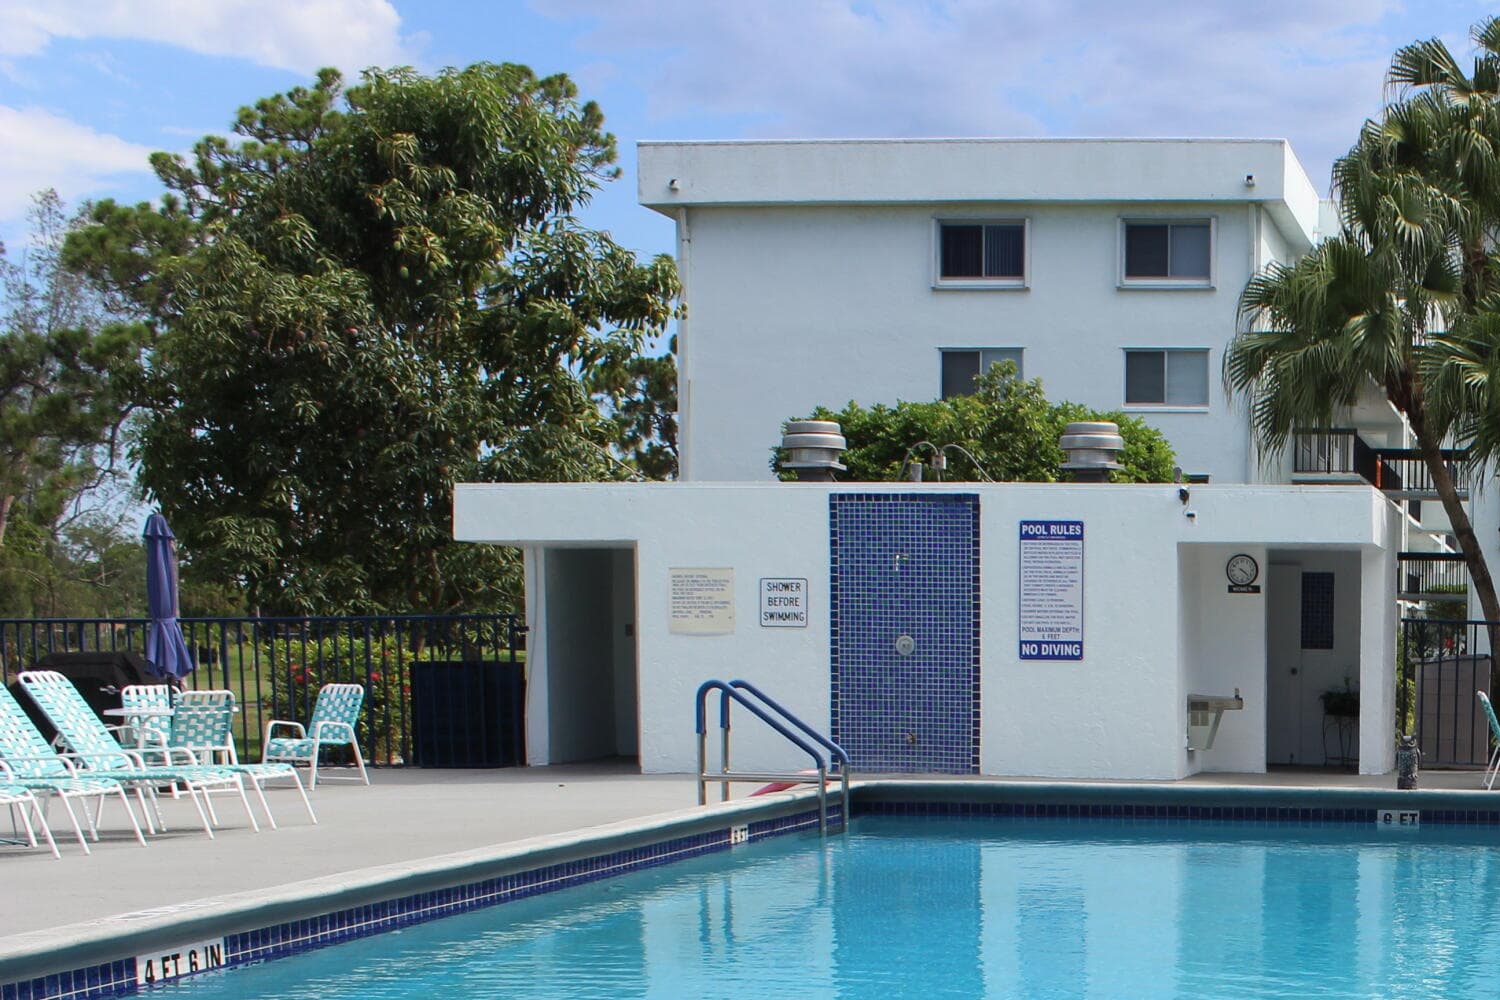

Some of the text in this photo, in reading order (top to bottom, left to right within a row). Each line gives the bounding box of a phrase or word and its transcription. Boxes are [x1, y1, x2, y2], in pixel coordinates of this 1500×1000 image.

[1022, 525, 1082, 535] POOL RULES
[767, 582, 801, 592] SHOWER
[768, 597, 800, 607] BEFORE
[763, 612, 805, 622] SWIMMING
[1022, 644, 1081, 656] NO DIVING
[145, 944, 222, 983] 4 FT 6 IN
